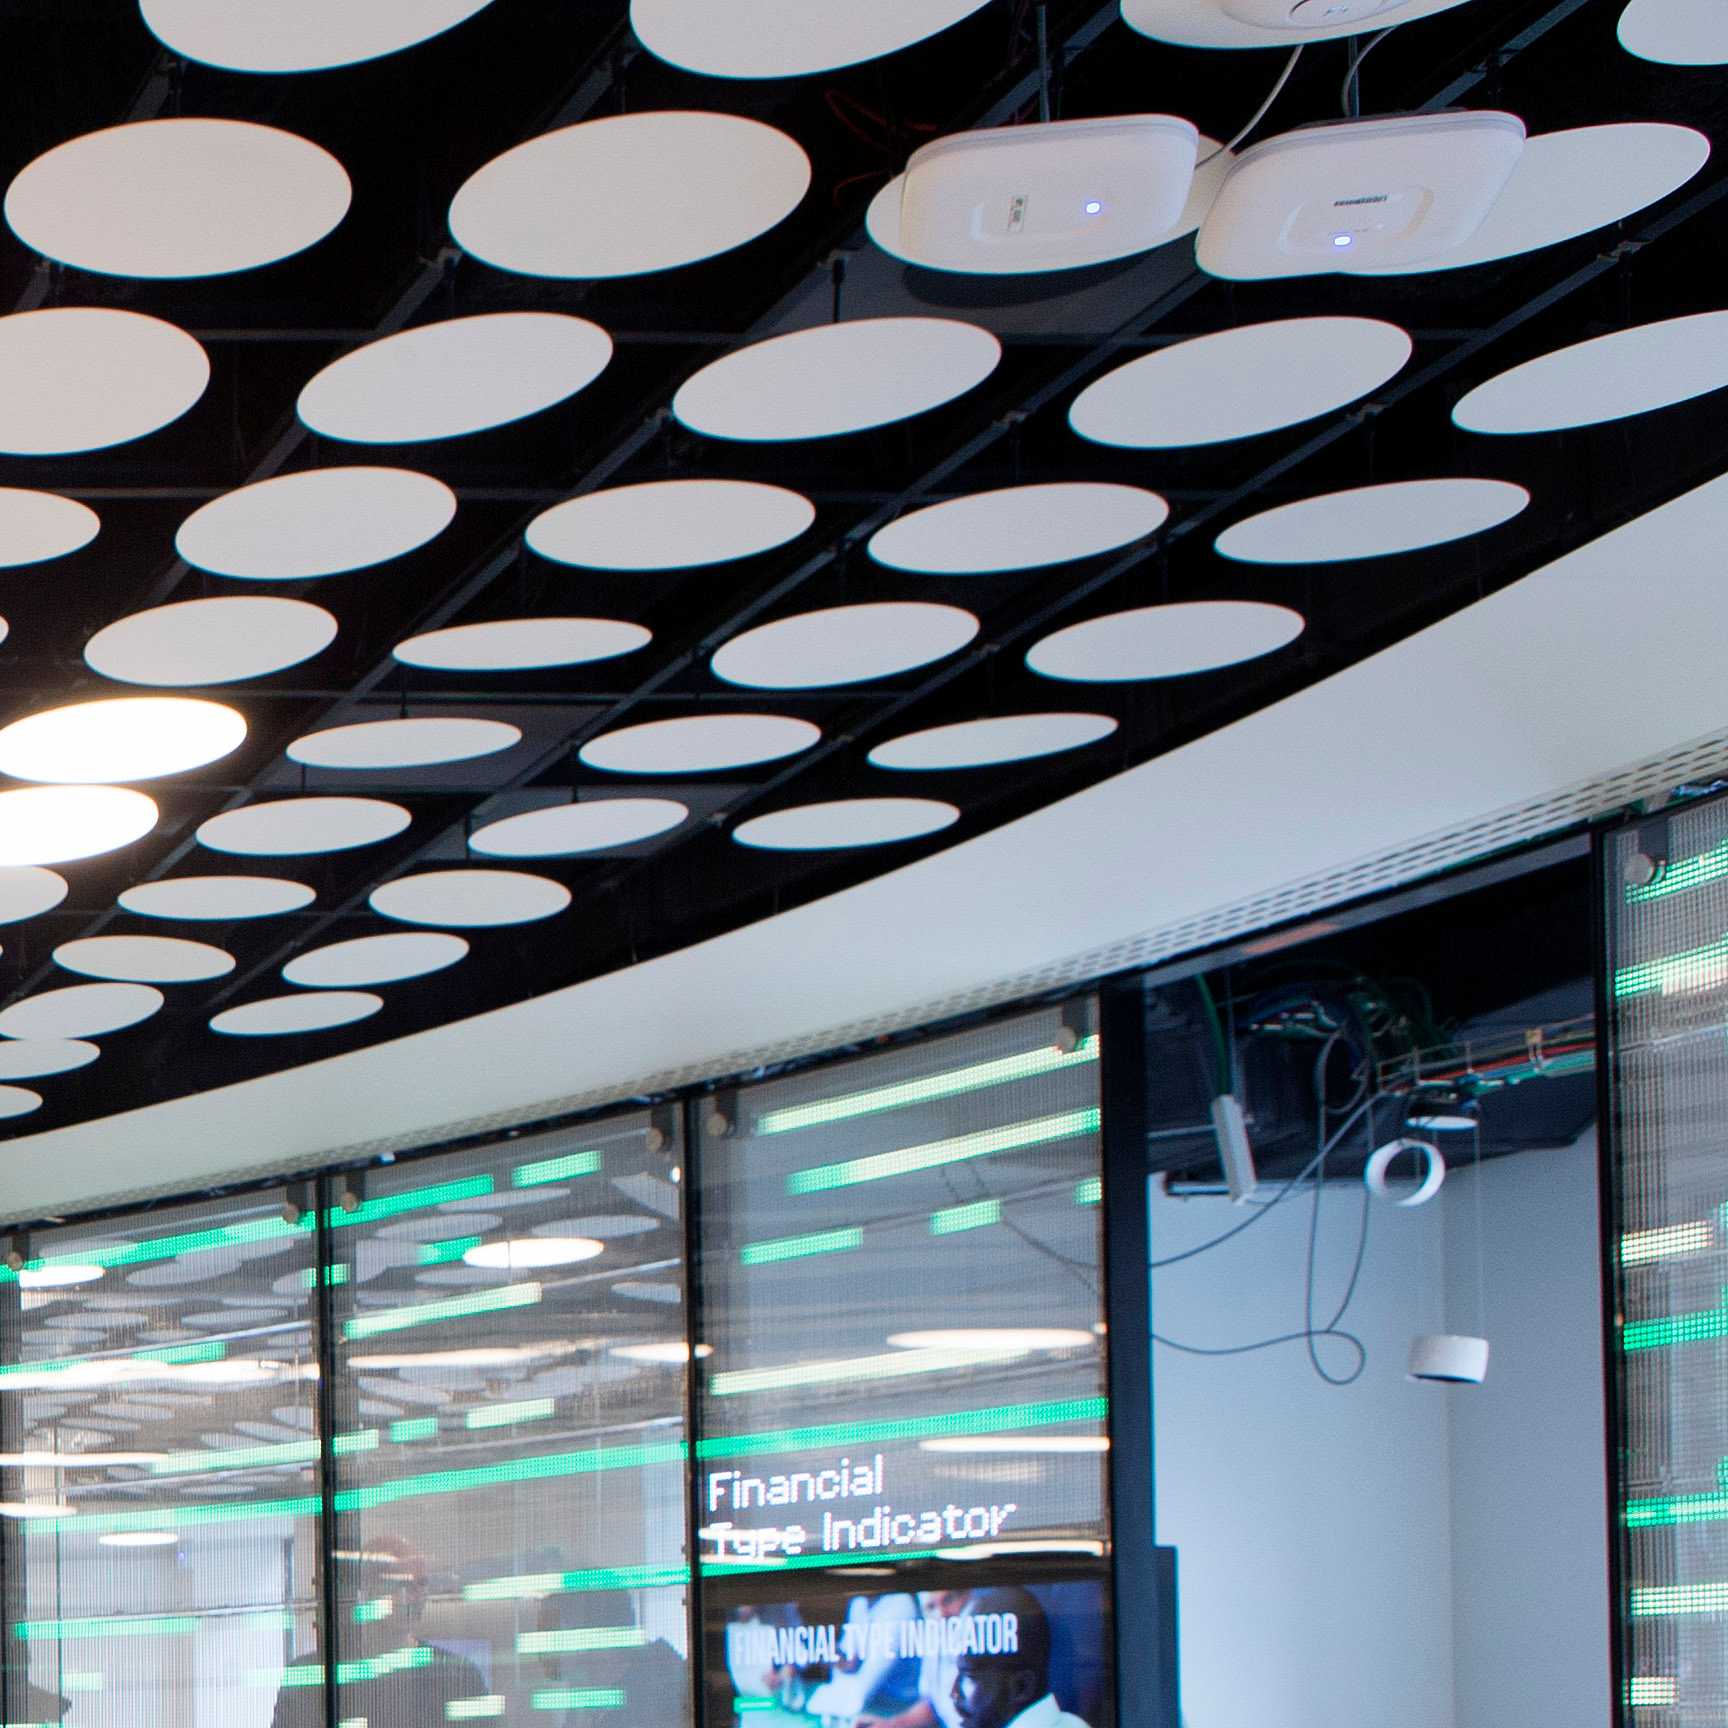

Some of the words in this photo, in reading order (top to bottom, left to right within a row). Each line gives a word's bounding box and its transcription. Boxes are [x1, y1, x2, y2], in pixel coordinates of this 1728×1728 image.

[708, 1453, 884, 1512] Financial
[823, 1503, 1018, 1551] Indicator
[734, 1624, 841, 1667] FINANCIAL
[843, 1621, 897, 1661] TYPE
[899, 1612, 1019, 1660] INDICATOR
